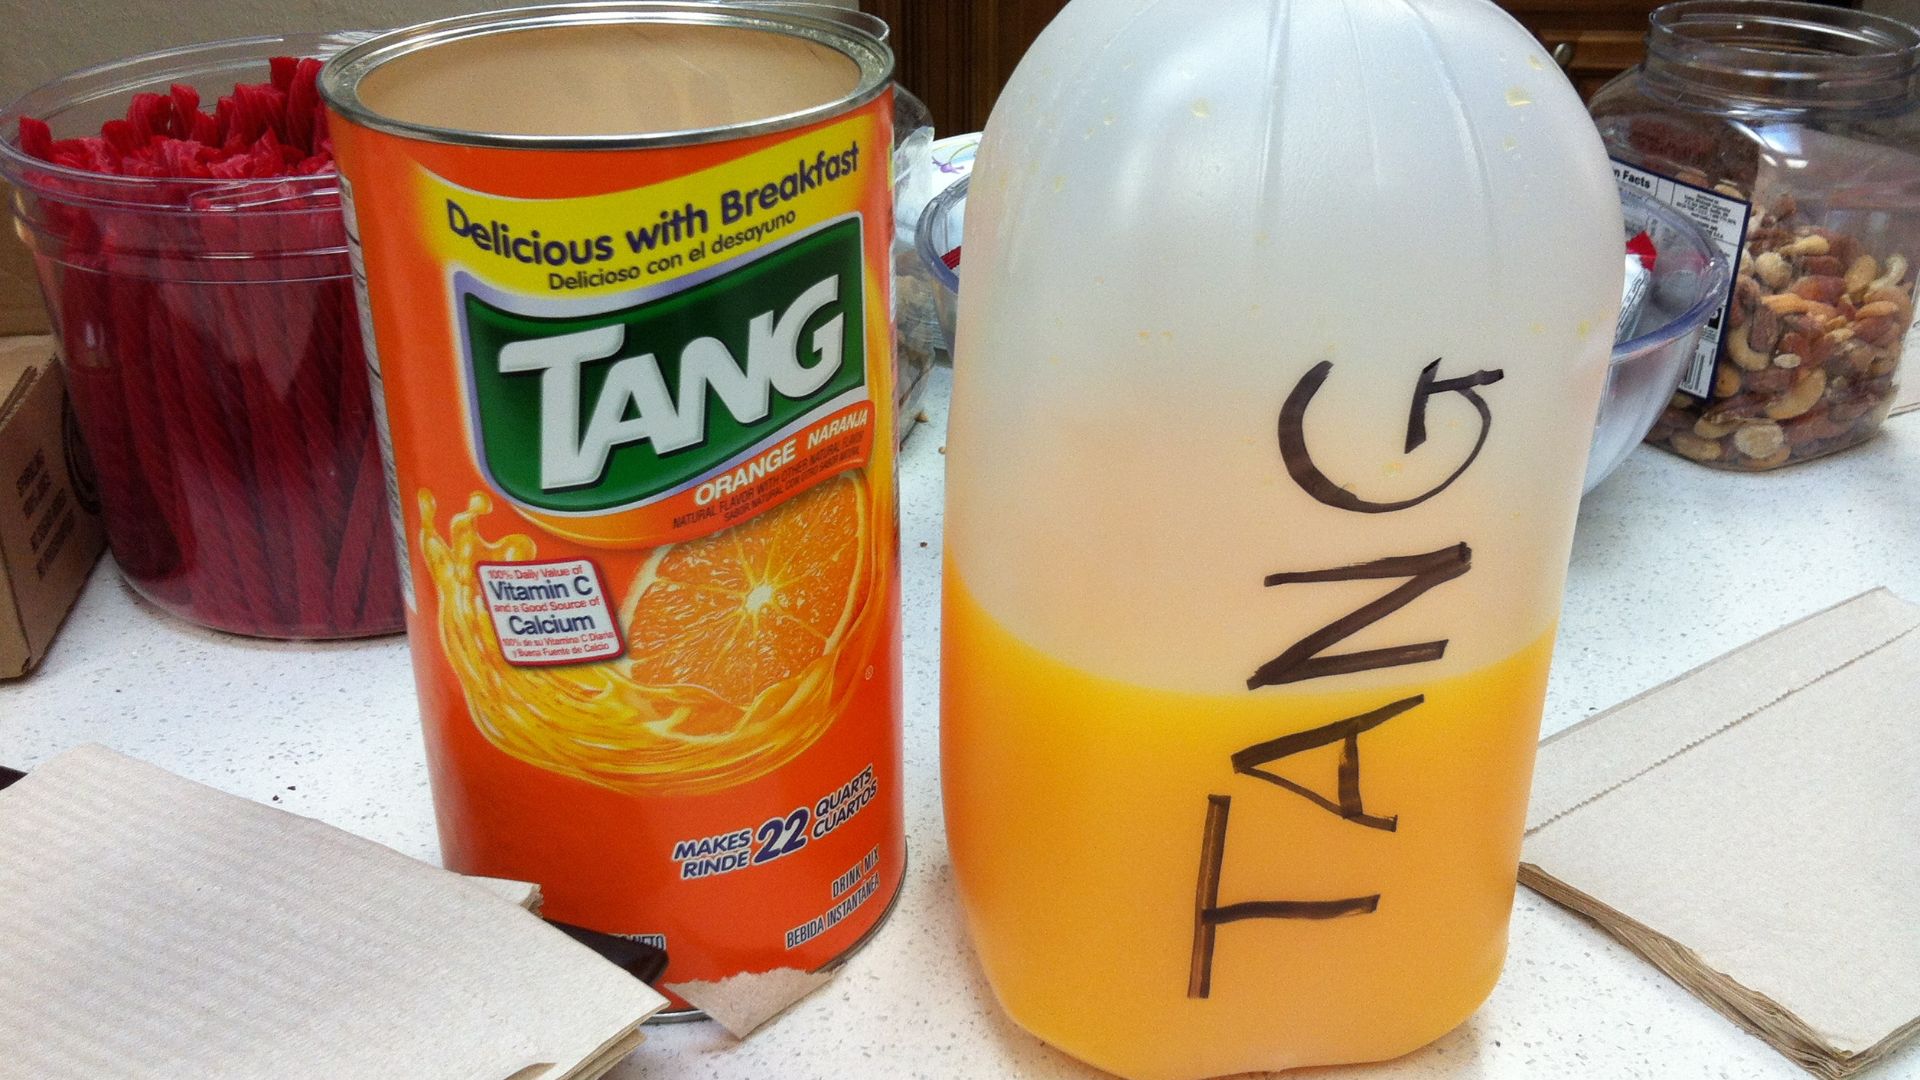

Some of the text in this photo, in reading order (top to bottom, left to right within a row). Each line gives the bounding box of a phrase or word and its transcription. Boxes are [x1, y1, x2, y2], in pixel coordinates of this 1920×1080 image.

[446, 140, 860, 266] Delicious with Breakfast
[1622, 170, 1651, 189] Facts
[548, 209, 796, 291] Delicioso con el desayuno
[498, 273, 844, 490] TANG
[694, 408, 869, 505] ORANGE NARANJA
[488, 575, 593, 600] Vitamin C
[494, 603, 512, 612] and
[520, 602, 548, 613] Good
[550, 600, 587, 611] Source
[589, 595, 601, 606] of
[514, 568, 539, 580] Daily
[539, 567, 571, 578] Value
[572, 565, 584, 575] of
[508, 614, 596, 635] Calcium
[1187, 357, 1504, 999] TANG
[674, 765, 873, 863] MAKES 22 QUARTS
[682, 780, 878, 878] RINDE CUARTOS
[831, 848, 880, 898] DRINK MIX
[786, 916, 825, 949] BEBIDA
